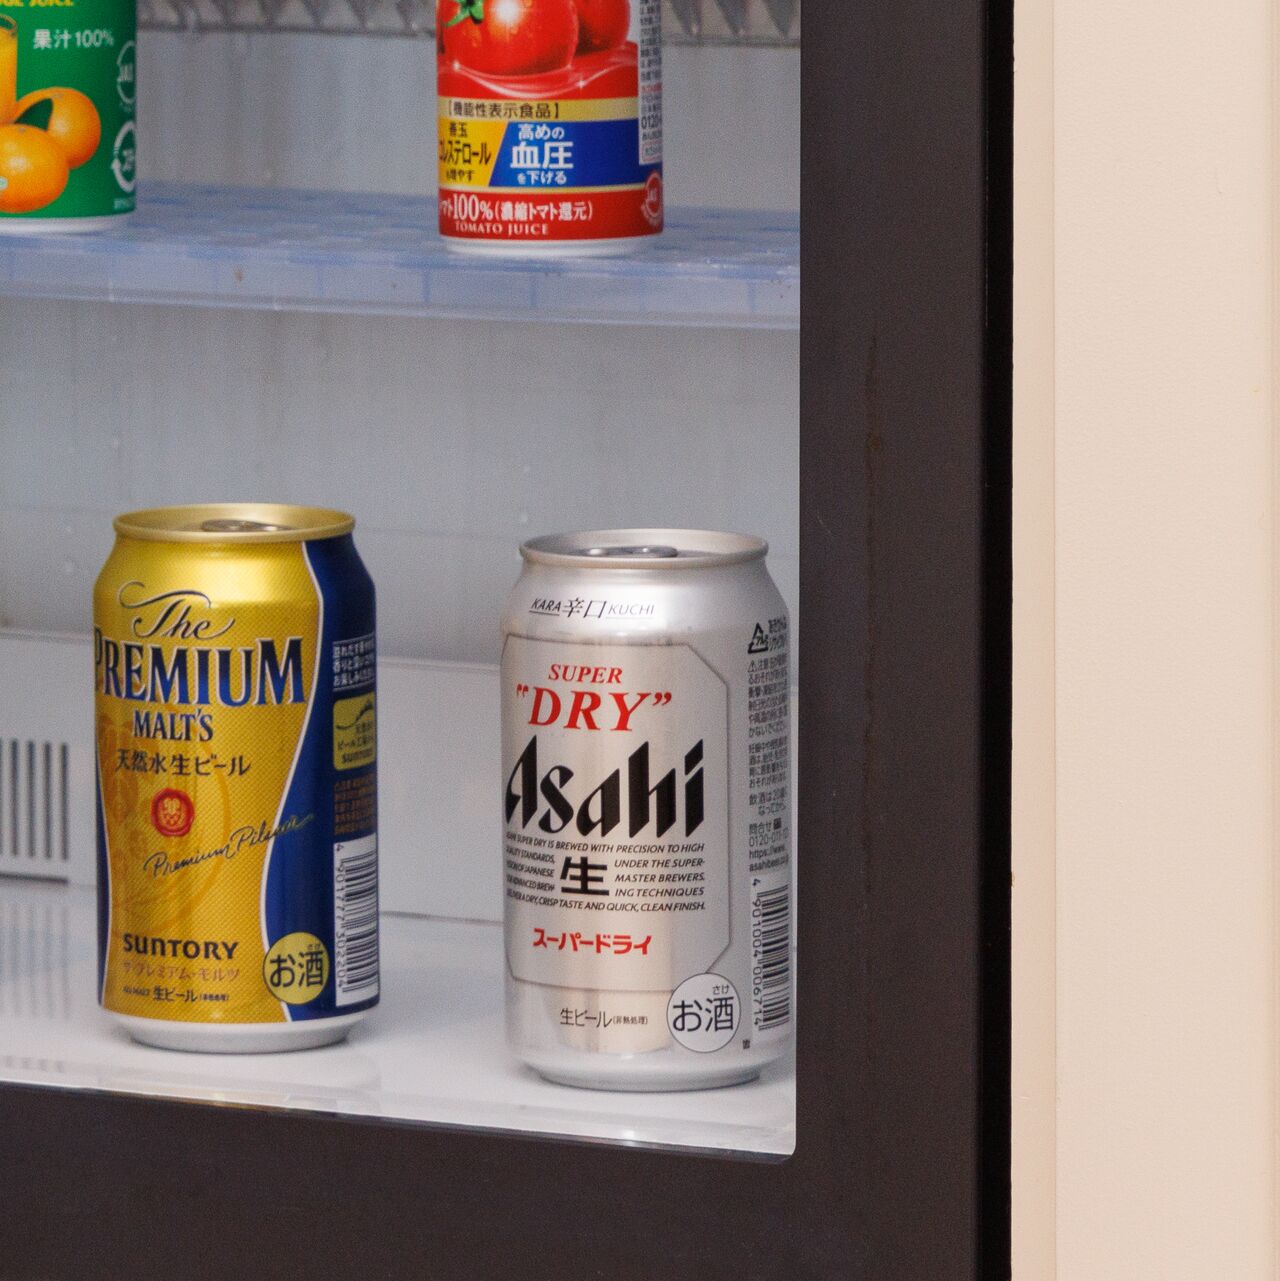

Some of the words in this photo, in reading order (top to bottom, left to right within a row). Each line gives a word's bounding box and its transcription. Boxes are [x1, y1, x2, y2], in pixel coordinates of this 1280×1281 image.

[33, 28, 114, 50] 果汁100%
[518, 123, 565, 140] 高めの
[510, 141, 574, 169] 血圧
[517, 170, 568, 186] を下げる
[508, 222, 549, 236] JUICE
[117, 581, 236, 641] The
[531, 597, 562, 613] KARA
[562, 597, 607, 618] 辛口
[608, 603, 655, 616] KUCHI
[94, 625, 307, 708] PREMIUM
[548, 663, 623, 684] SUPER
[133, 708, 214, 742] MALT'S
[116, 748, 252, 776] 天然水生ビール
[505, 734, 704, 839] Asahi
[555, 841, 588, 852] BREWED
[590, 843, 614, 854] WITH
[616, 844, 665, 854] PRECISION
[667, 844, 679, 853] TO
[681, 843, 705, 853] HIGH
[614, 859, 649, 868] UNDER
[651, 859, 670, 868] THE
[560, 856, 609, 897] 生
[615, 874, 656, 883] MASTER
[752, 878, 761, 886] 4
[615, 888, 634, 897] ING
[636, 887, 705, 898] TECHNIQUES
[560, 899, 583, 910] TASTE
[584, 900, 605, 910] AND
[607, 902, 639, 913] QUICK,
[641, 902, 672, 912] CLEAN
[752, 898, 762, 957] 901004
[123, 933, 239, 960] SUNTORY
[532, 927, 653, 956] スーパードライ
[269, 949, 325, 989] お酒
[712, 984, 730, 995] さけ
[752, 966, 762, 1026] 006714
[672, 996, 735, 1033] お酒
